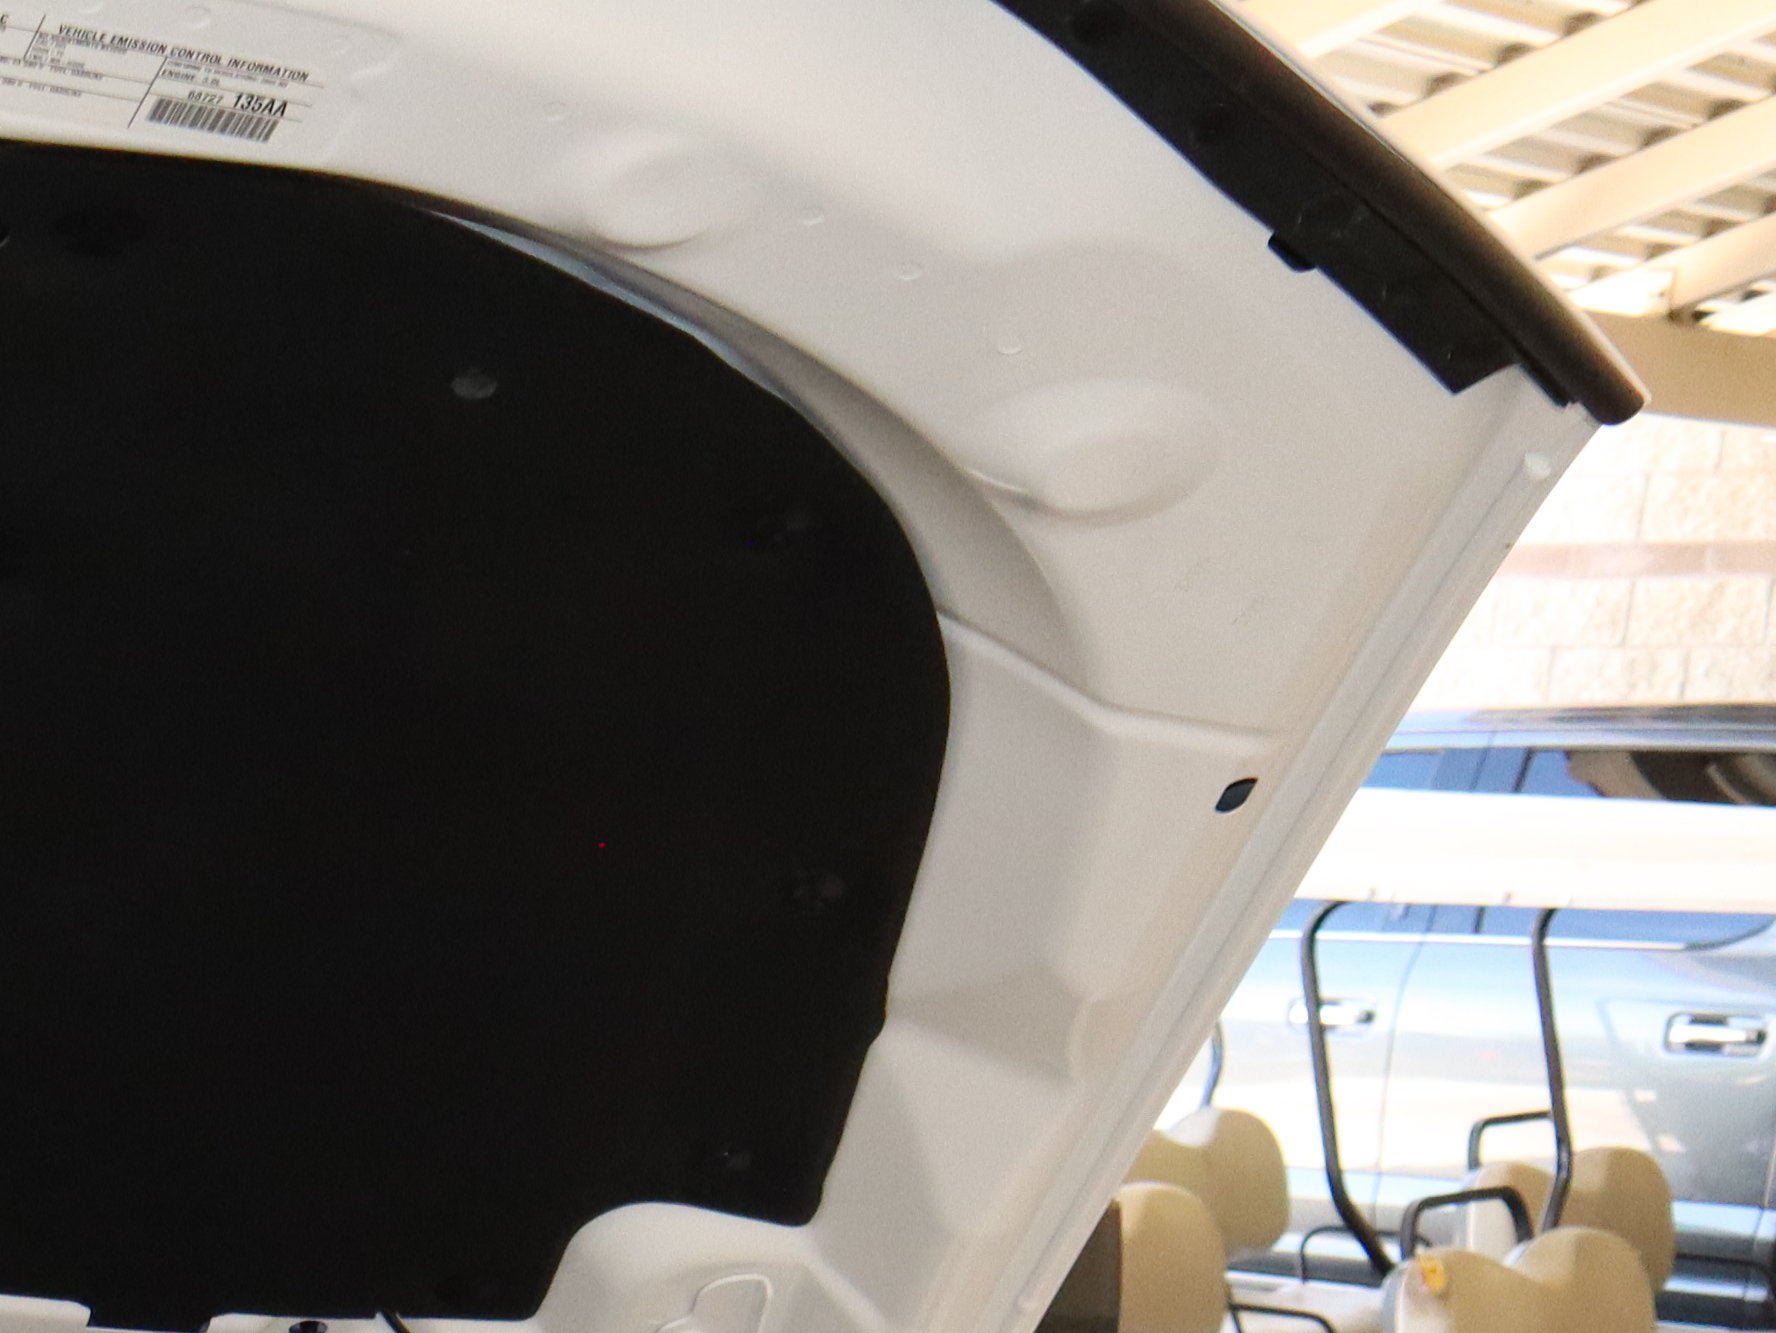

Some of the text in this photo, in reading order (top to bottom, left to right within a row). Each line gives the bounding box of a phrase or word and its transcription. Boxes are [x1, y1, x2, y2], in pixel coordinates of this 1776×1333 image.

[58, 24, 106, 43] VEHICLE
[110, 34, 167, 55] EMISSION
[170, 47, 223, 66] CONTROL
[227, 58, 309, 82] INFORMATION
[232, 91, 289, 118] 135AA
